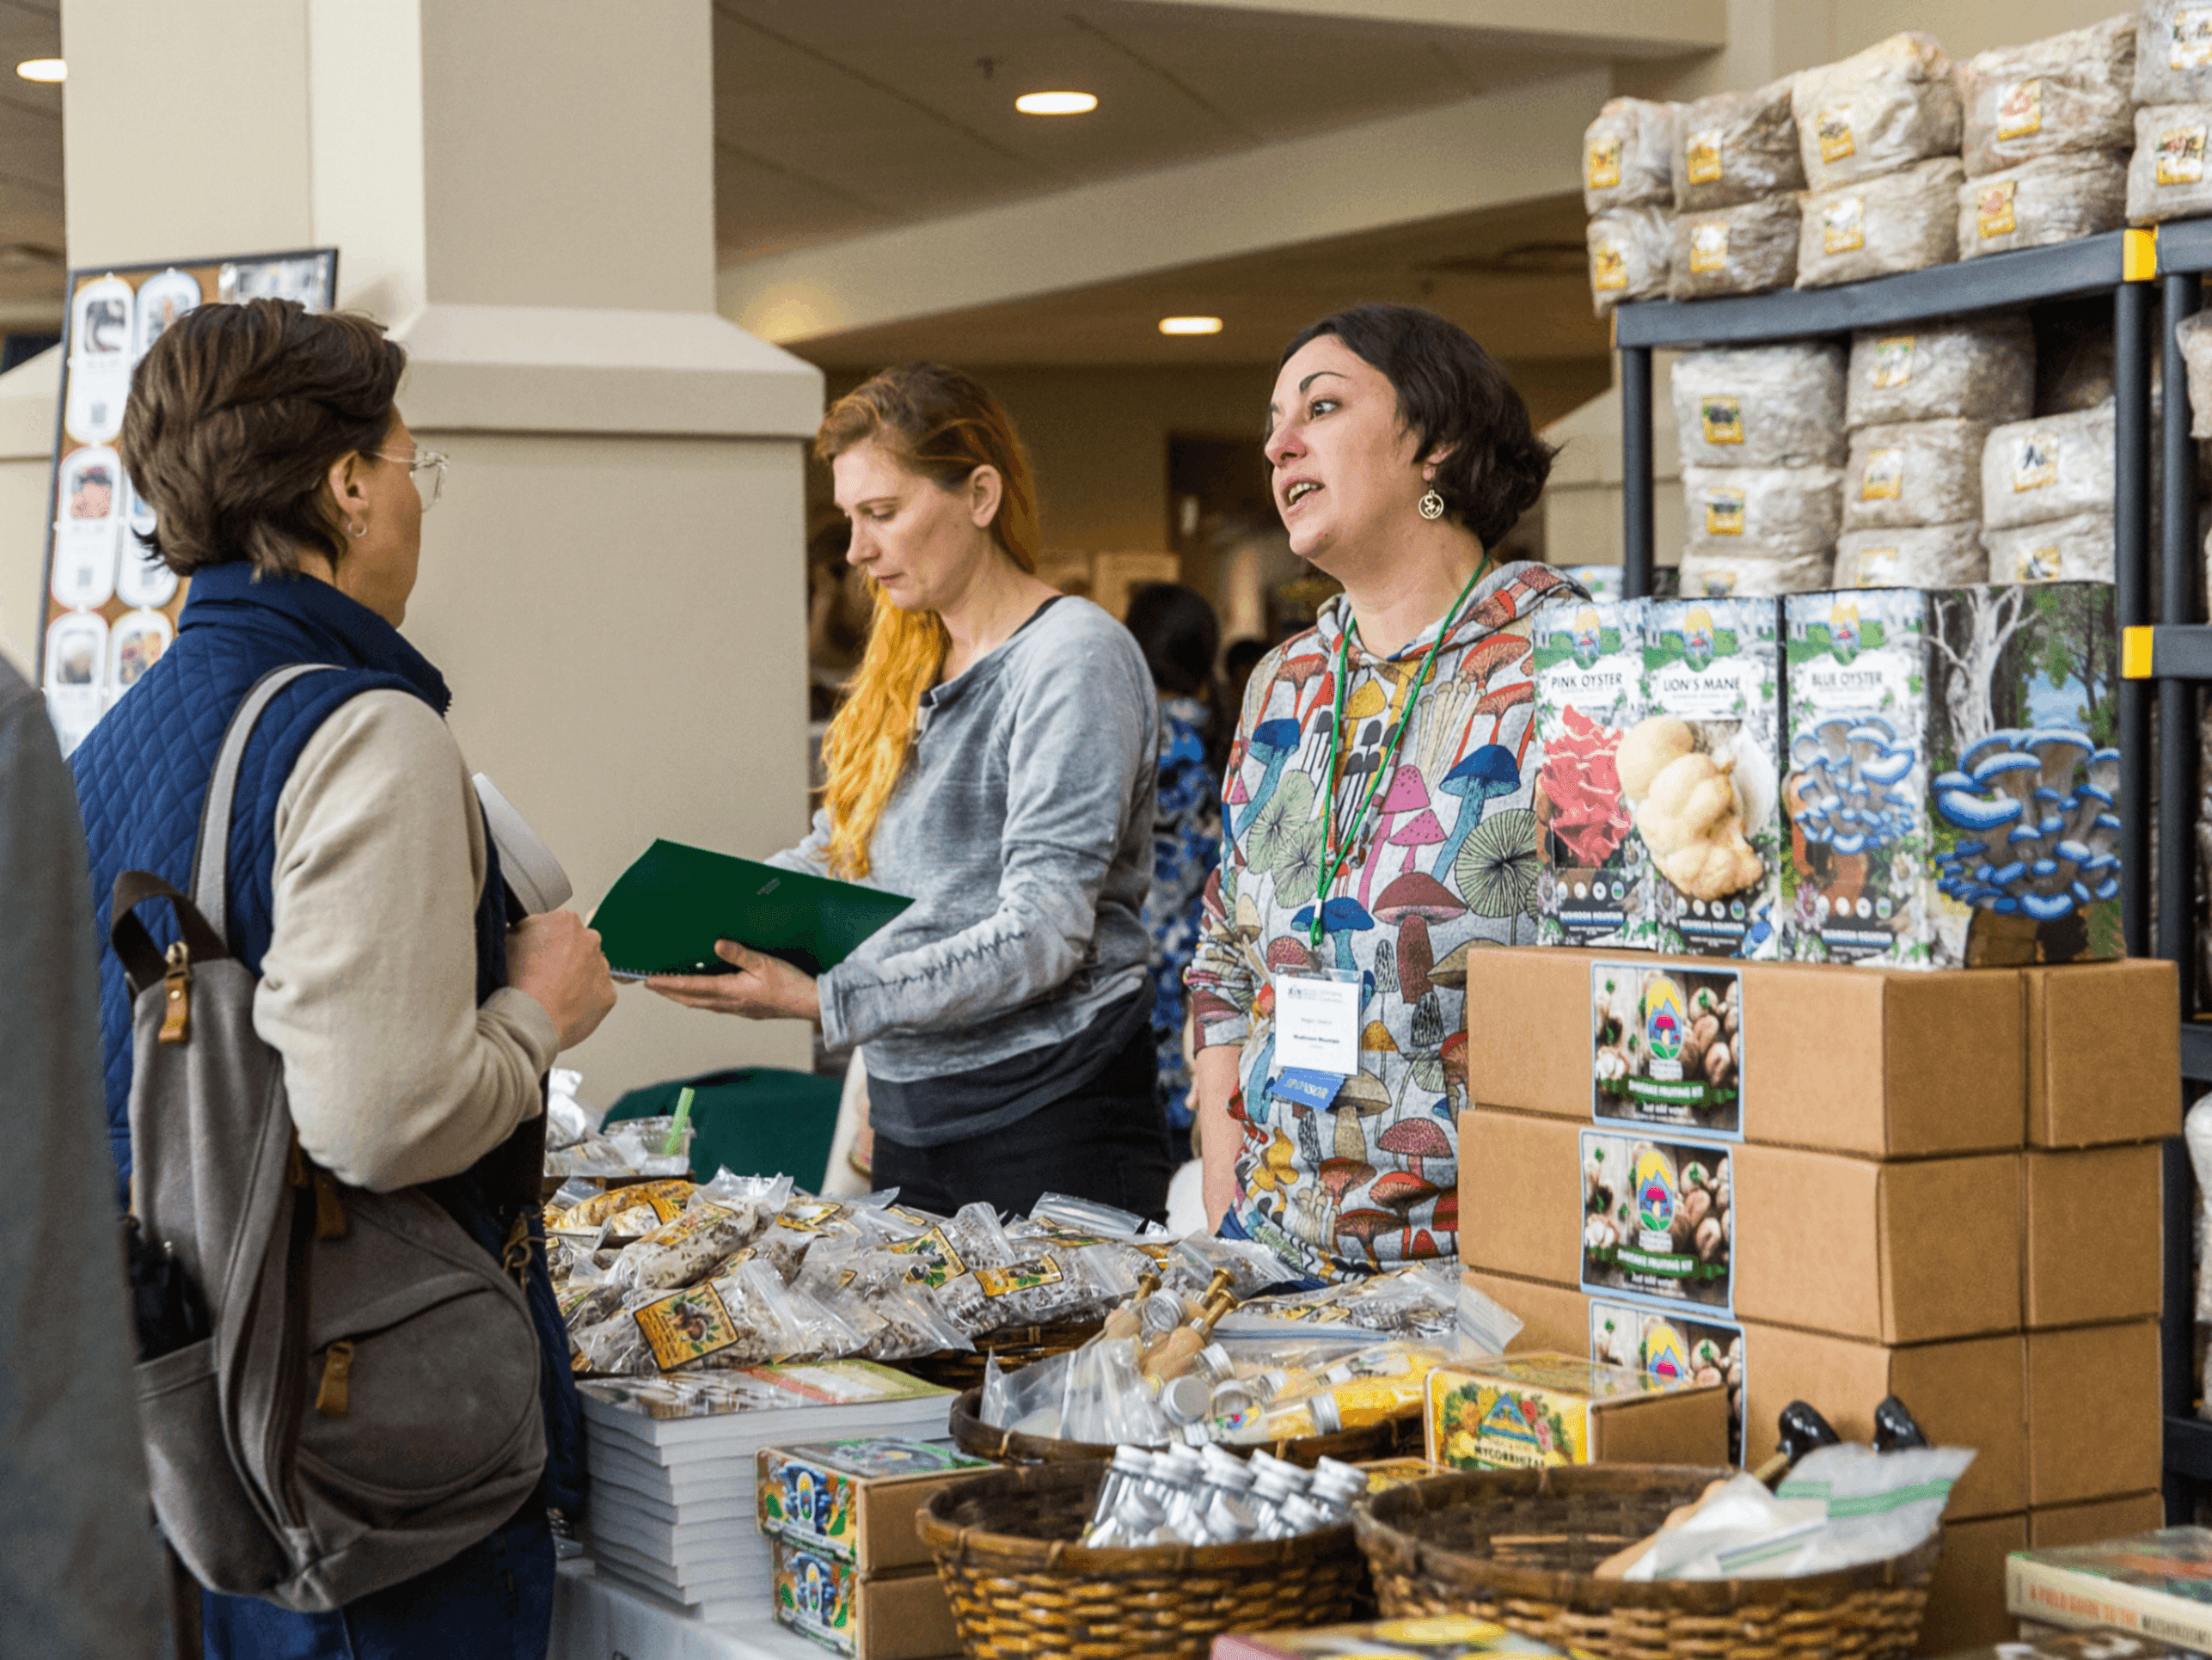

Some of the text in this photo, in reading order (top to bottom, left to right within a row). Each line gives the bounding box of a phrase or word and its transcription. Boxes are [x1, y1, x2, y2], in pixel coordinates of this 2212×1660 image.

[1551, 671, 1623, 689] PINK OYSTER
[1663, 676, 1740, 692] LION'S MANE
[1811, 671, 1883, 686] BLUE OYSTER
